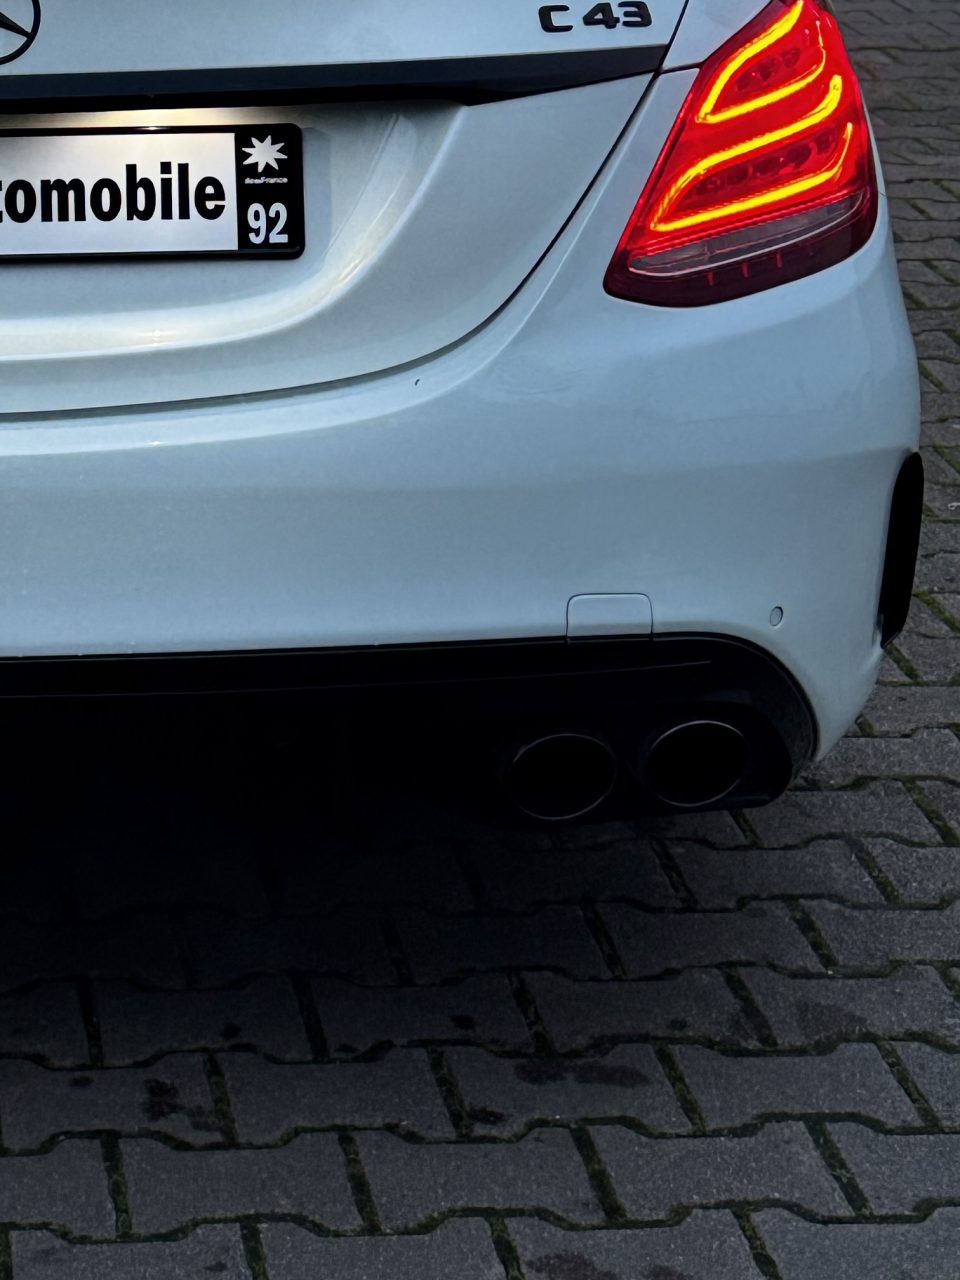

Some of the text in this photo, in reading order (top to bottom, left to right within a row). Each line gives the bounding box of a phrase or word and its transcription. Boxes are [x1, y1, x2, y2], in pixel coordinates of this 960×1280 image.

[538, 0, 652, 33] C 43
[247, 202, 289, 245] 92
